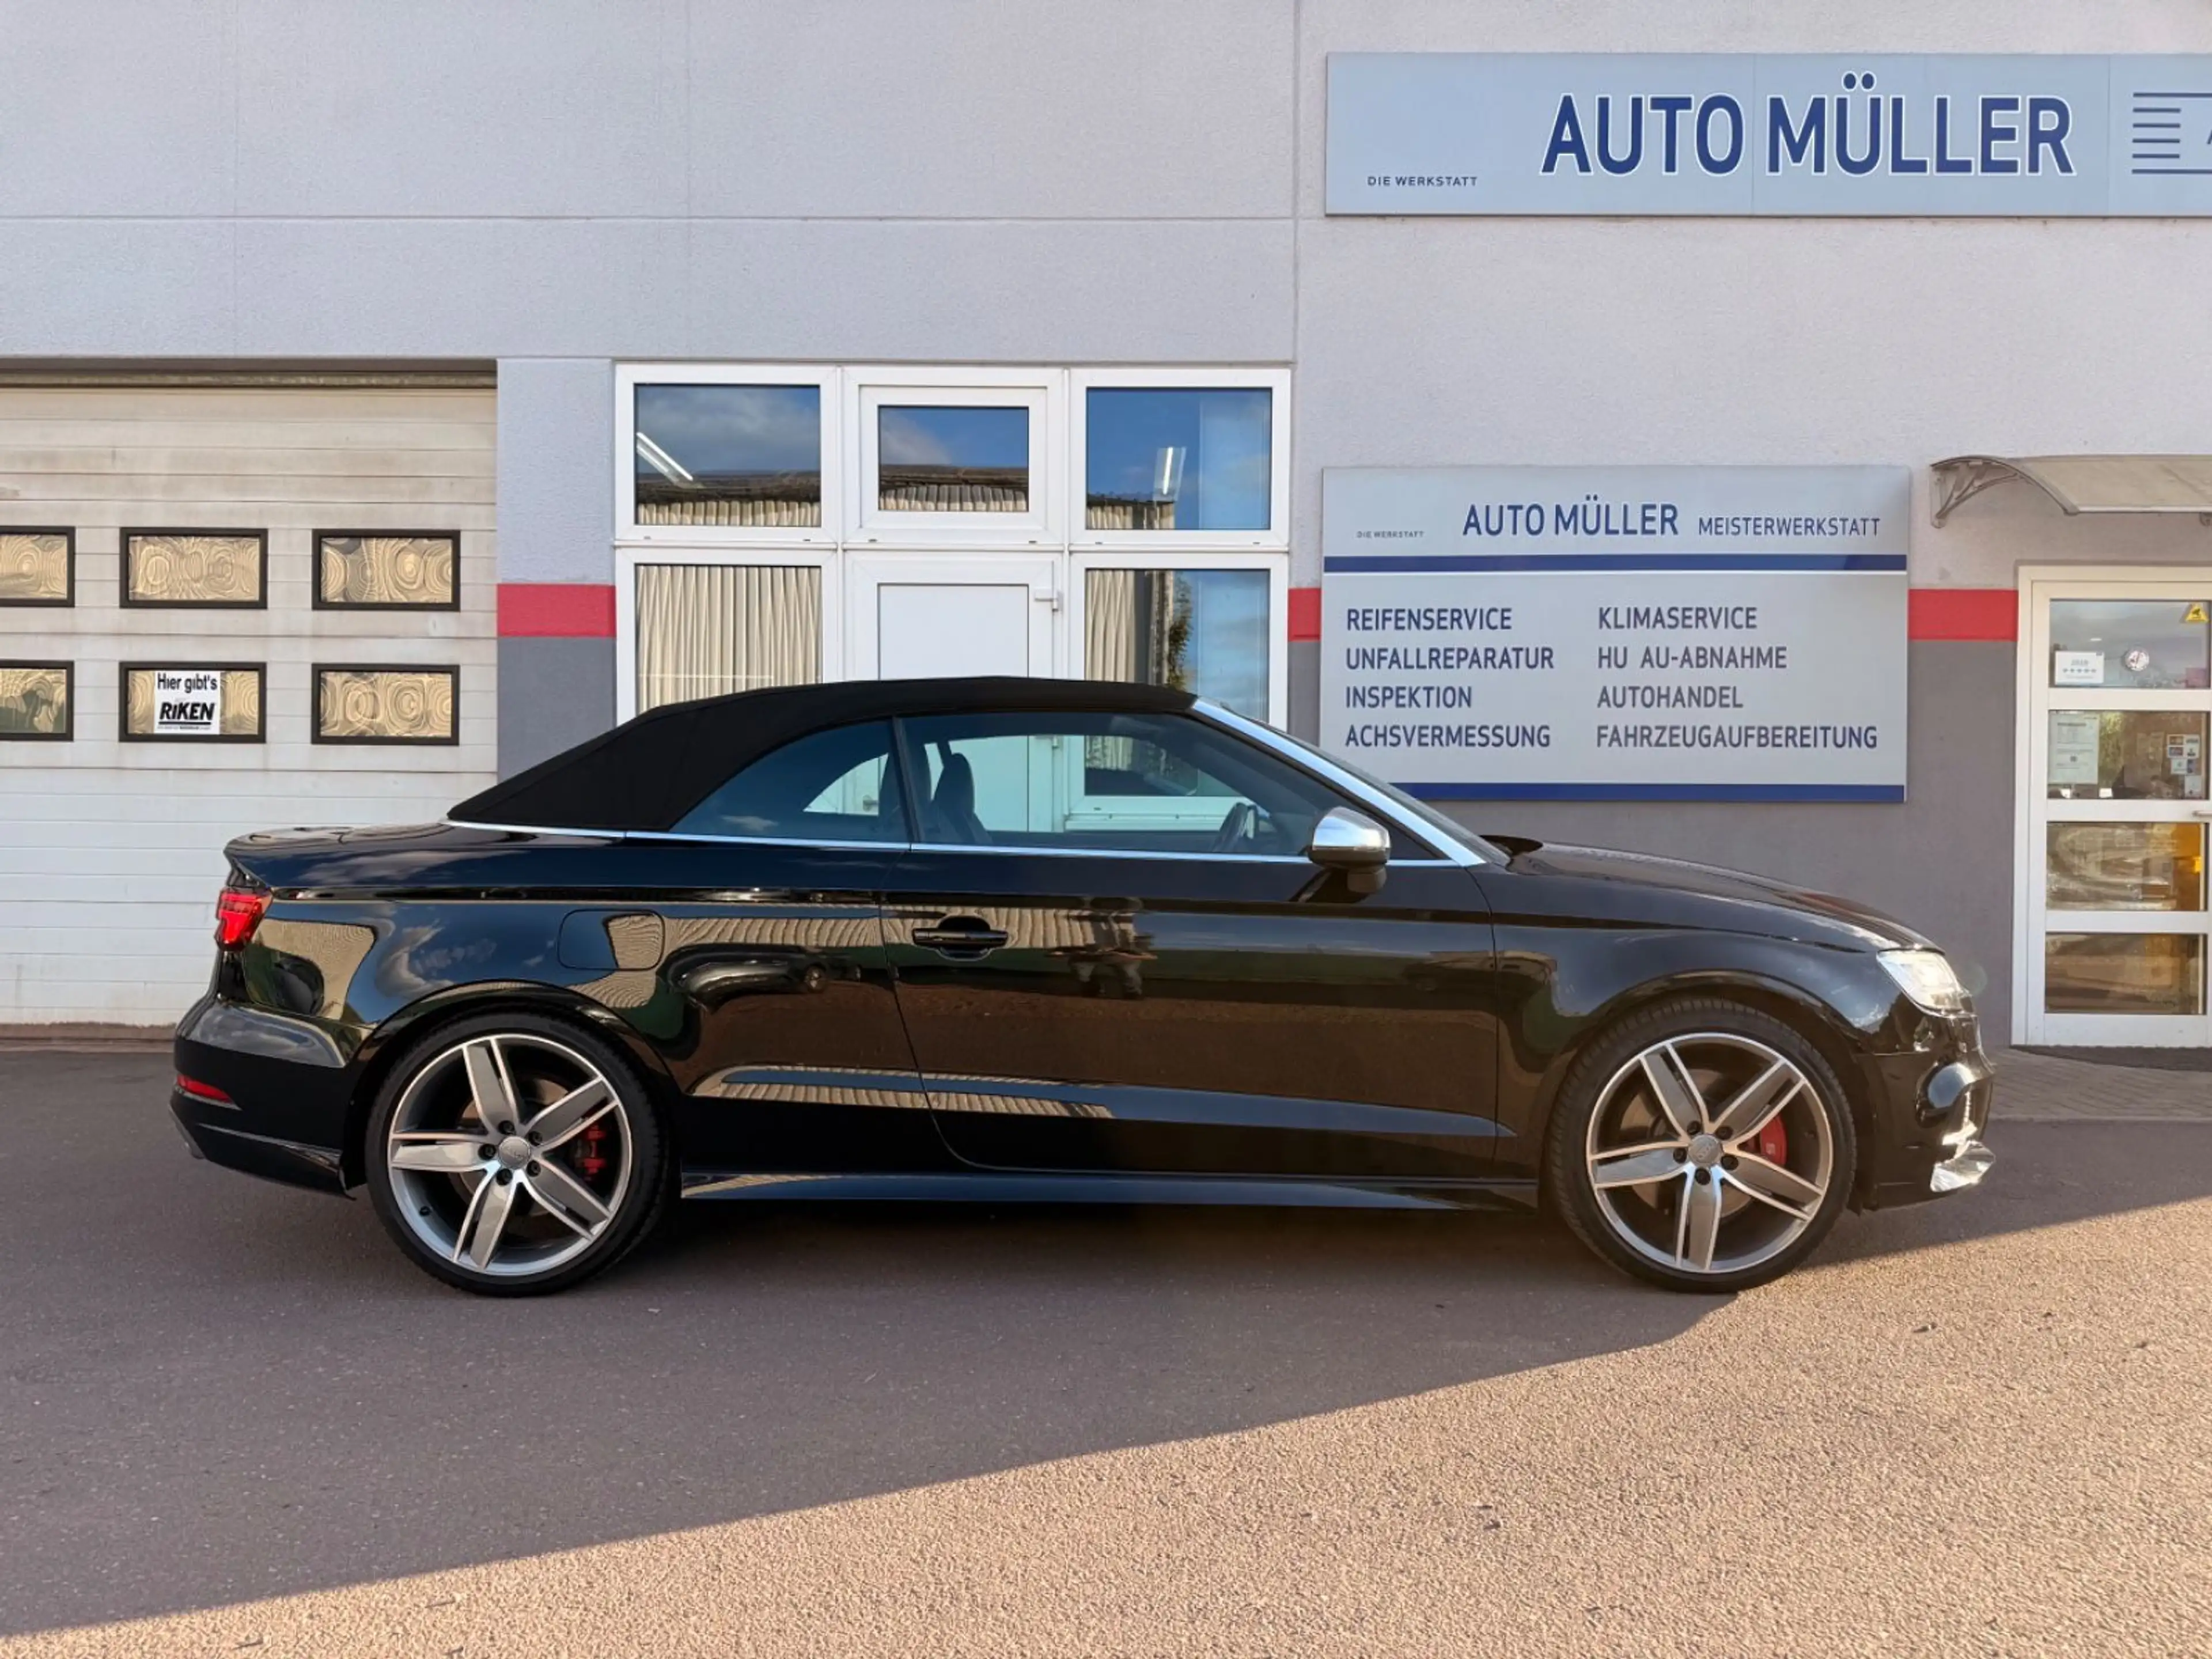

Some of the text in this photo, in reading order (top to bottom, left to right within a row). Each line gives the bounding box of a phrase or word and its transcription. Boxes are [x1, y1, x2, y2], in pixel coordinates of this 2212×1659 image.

[1539, 70, 2077, 176] AUTO MÜLLER
[1367, 176, 1478, 187] DIE WERKSTATT
[1462, 494, 1881, 537] AUTO MÜLLER MEISTERWERKSTATT
[1347, 607, 1513, 631] REIFENSERVICE
[1599, 606, 1758, 630] KLIMASERVICE
[1346, 646, 1554, 671] UNFALLREPARATUR
[1597, 645, 1787, 669] HU AU-ABNAHME
[157, 672, 218, 694] Hier gibt's
[1346, 685, 1472, 709] INSPEKTION
[1596, 685, 1744, 709] AUTOHANDEL
[1344, 724, 1551, 748] ACHSVERMESSUNG
[1596, 725, 1878, 749] FAHRZEUGAUFBEREITUNG
